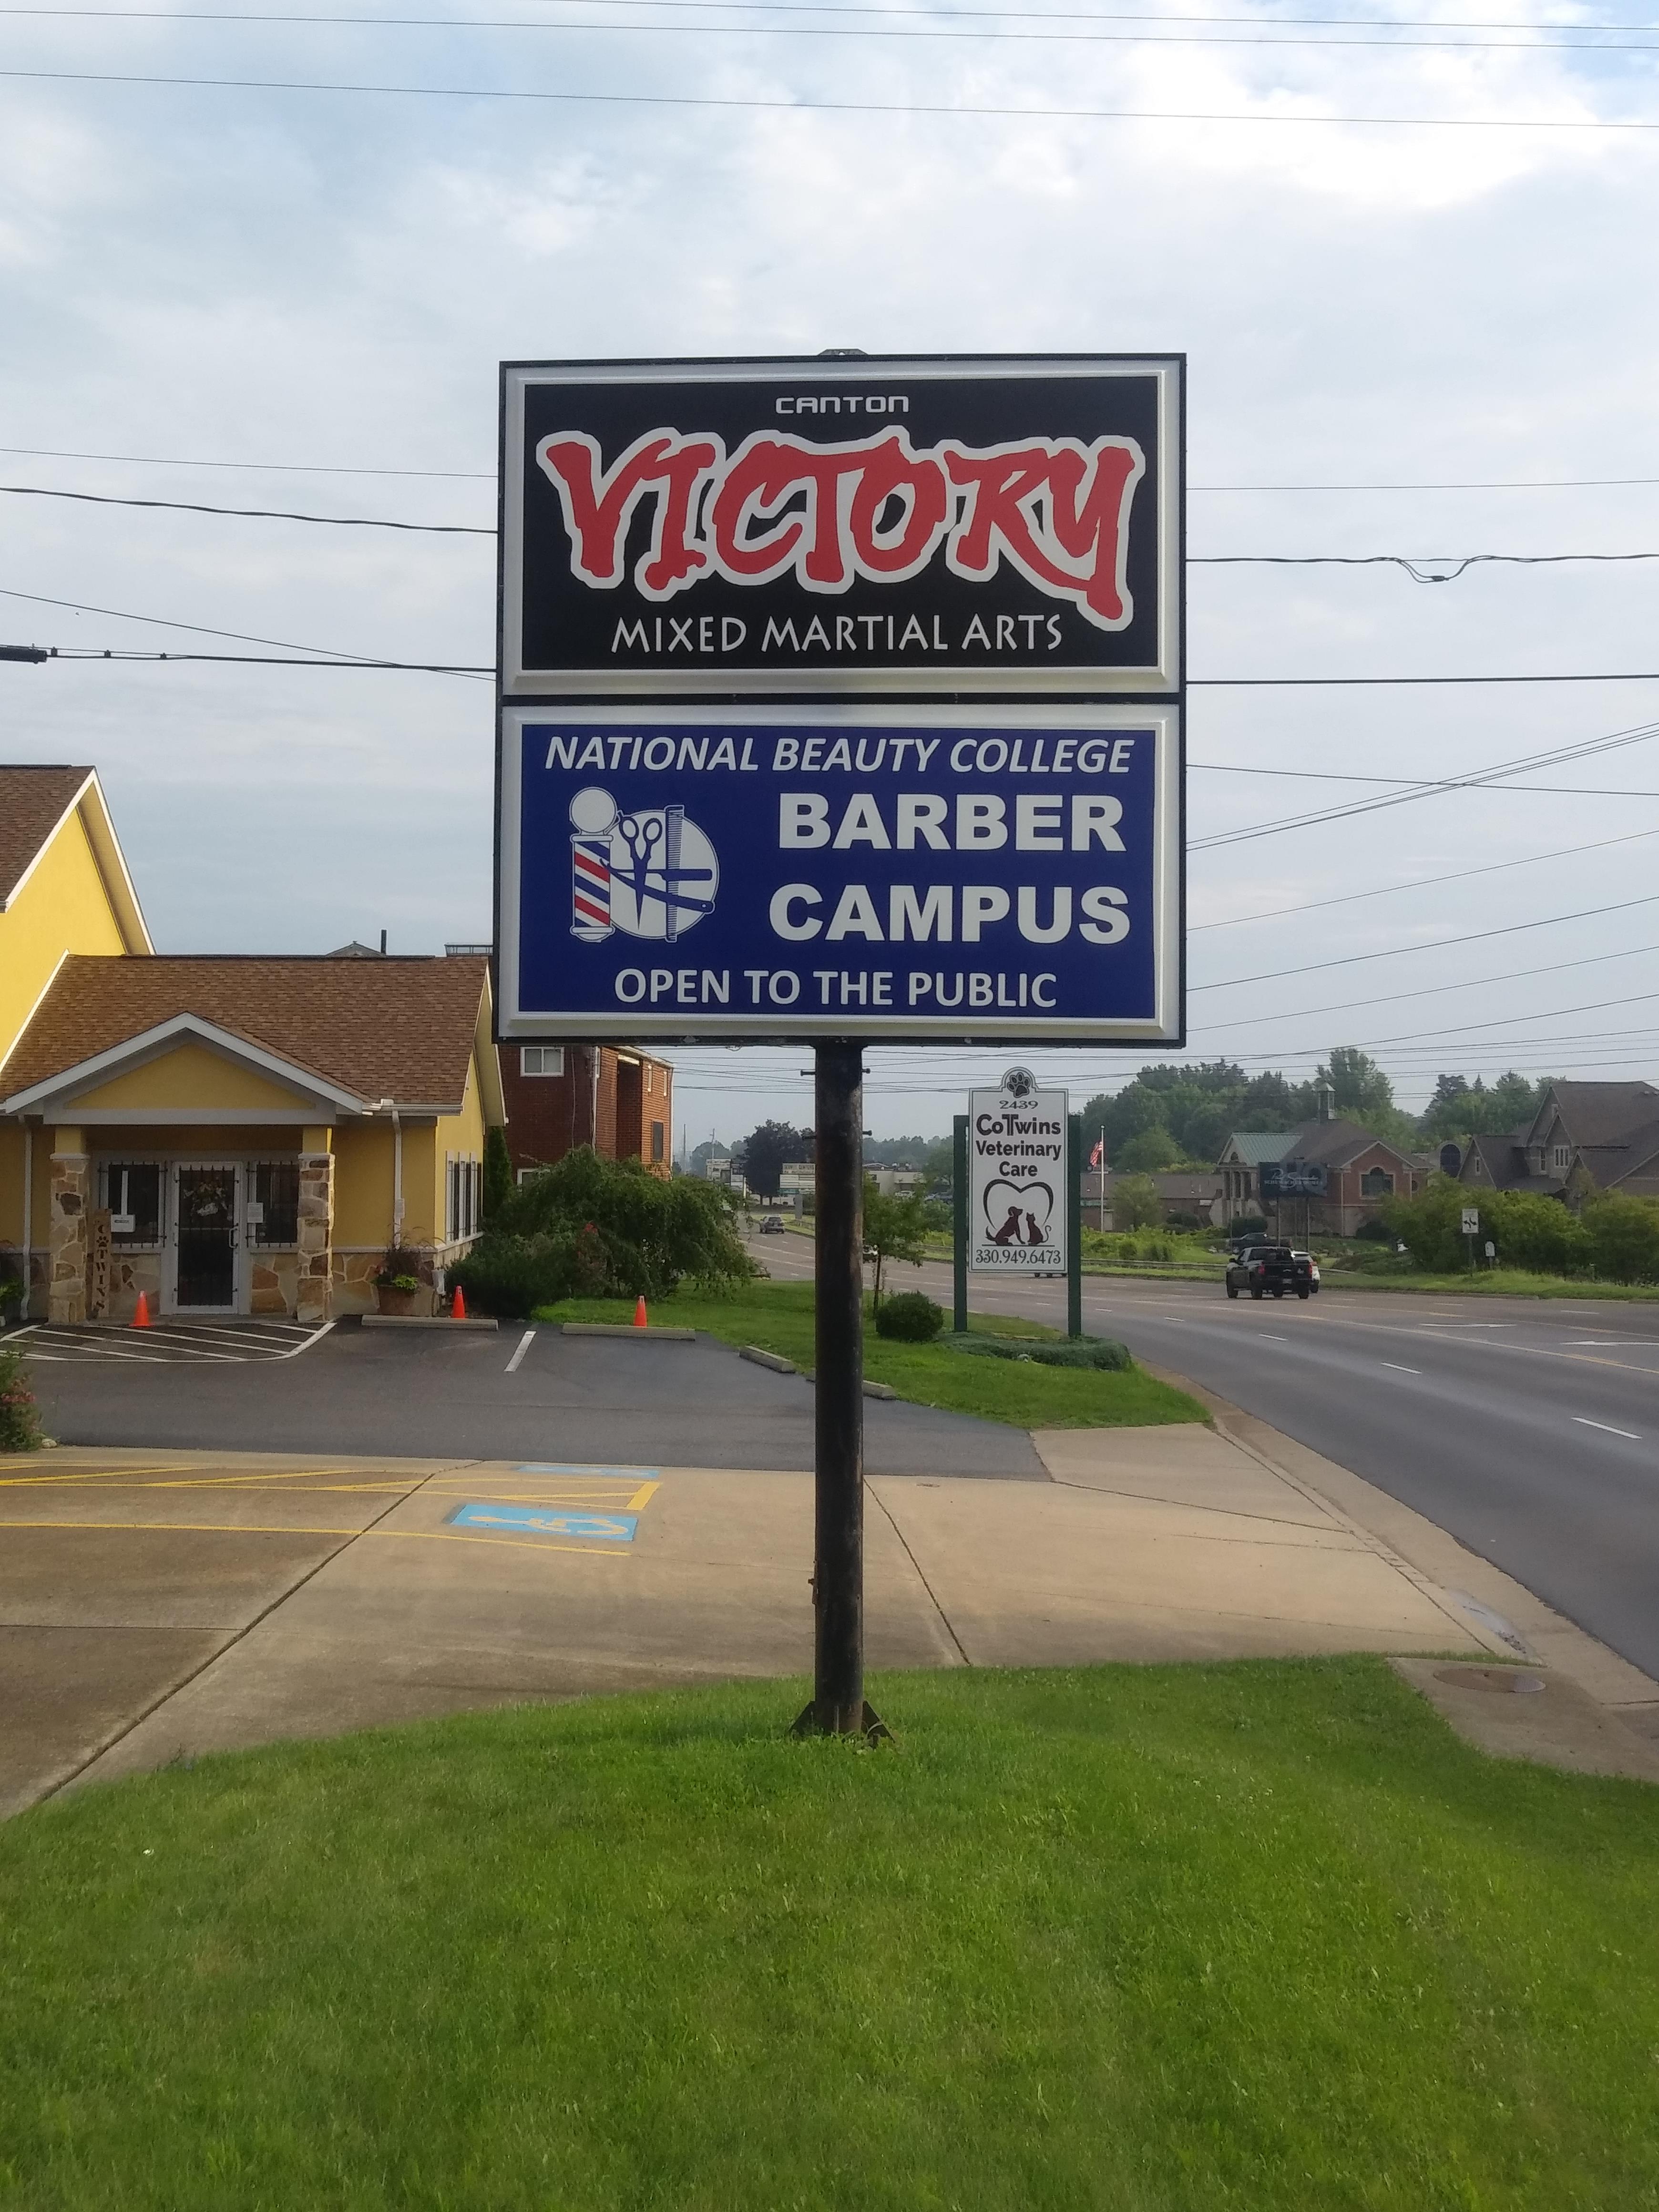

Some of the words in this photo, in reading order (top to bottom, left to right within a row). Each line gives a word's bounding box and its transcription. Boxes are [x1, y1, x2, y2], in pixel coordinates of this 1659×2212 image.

[776, 396, 909, 414] CANTON
[537, 426, 1145, 631] VICTORY
[611, 616, 747, 654] MIXED
[761, 614, 948, 652] MARTIAL
[961, 613, 1062, 651] ARTS
[545, 736, 758, 771] NATIONAL
[772, 738, 941, 772] BEAUTY
[950, 738, 1136, 773] COLLEGE
[779, 793, 1126, 851] BARBER
[769, 883, 1130, 944] CAMPUS
[615, 968, 729, 1003] OPEN
[744, 970, 800, 1004] TO
[813, 971, 893, 1005] THE
[909, 972, 1056, 1007] PUBLIC
[999, 1100, 1038, 1109] 2439
[976, 1114, 1061, 1136] CoTwins
[975, 1140, 1062, 1161] Veterinary
[999, 1161, 1038, 1177] Care
[975, 1249, 1061, 1264] 330.949.6473
